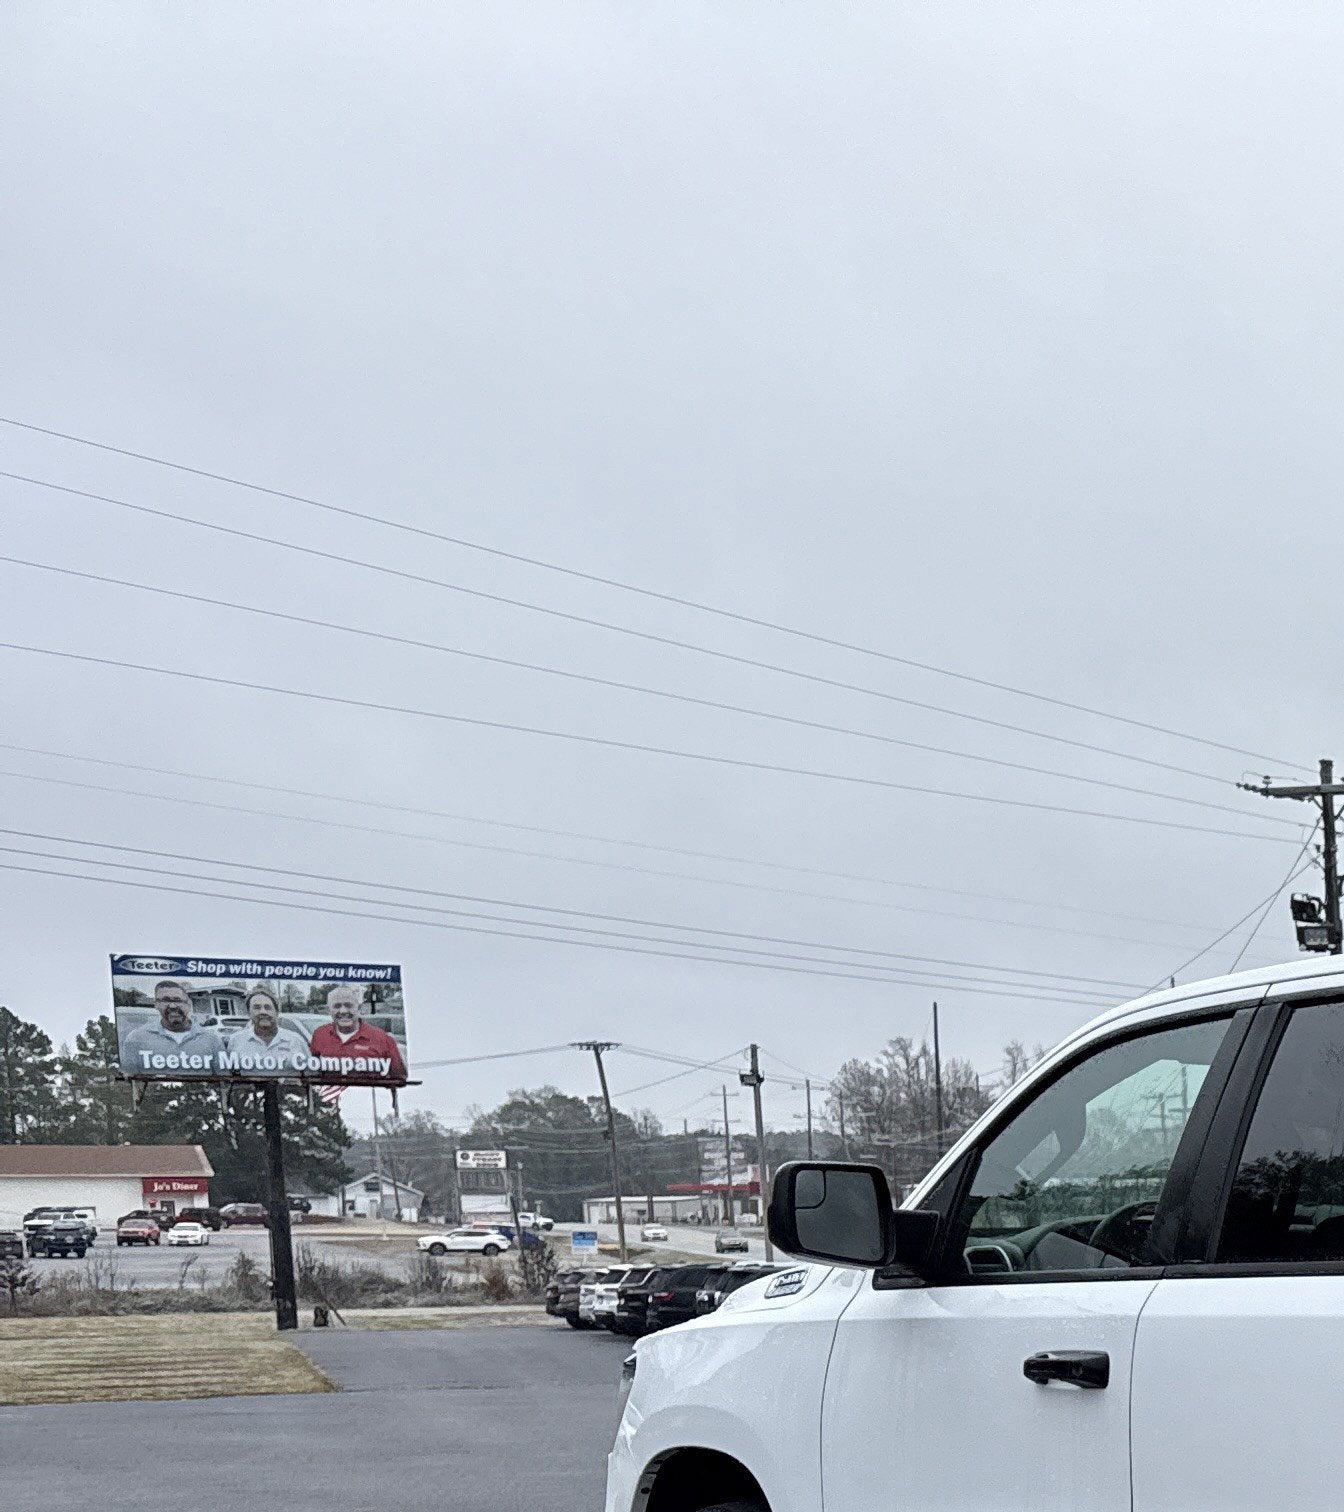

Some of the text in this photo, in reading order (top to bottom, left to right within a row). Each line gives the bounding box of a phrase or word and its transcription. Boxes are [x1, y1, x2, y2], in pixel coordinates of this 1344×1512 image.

[129, 960, 174, 970] Teeter
[186, 960, 392, 980] Shop with people you know!
[139, 1050, 392, 1076] Teeter Motor Company
[172, 1182, 199, 1191] Diner
